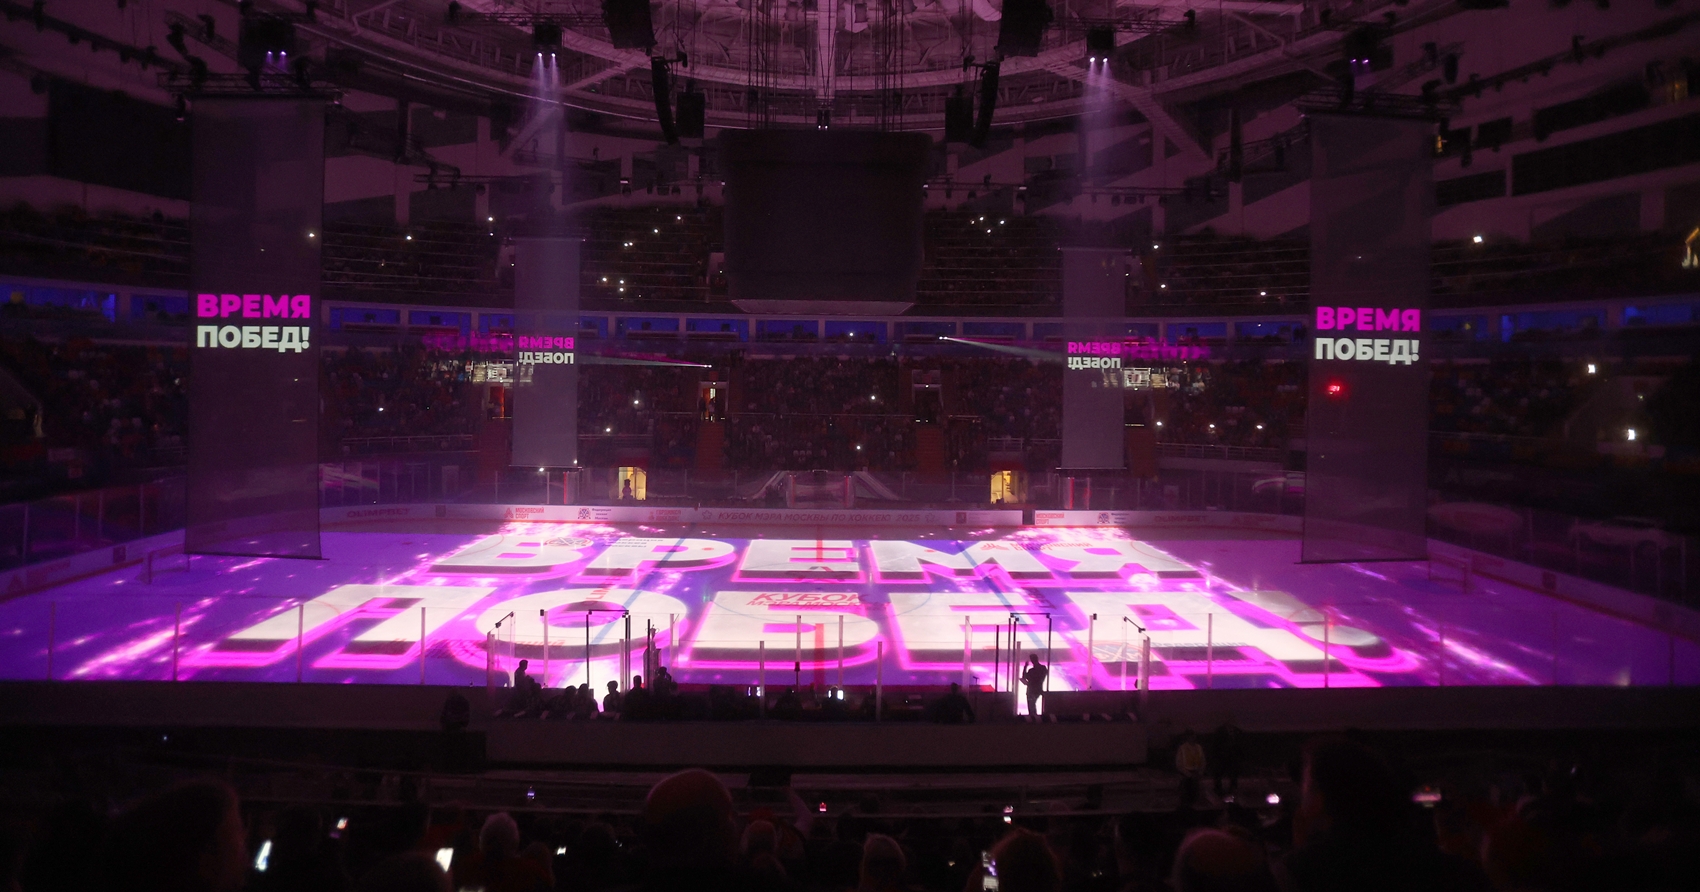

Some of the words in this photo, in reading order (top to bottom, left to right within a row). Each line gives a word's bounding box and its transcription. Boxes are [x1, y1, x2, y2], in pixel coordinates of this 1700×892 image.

[197, 294, 311, 319] ВРЕМЯ
[1316, 306, 1421, 332] ВРЕМЯ
[197, 325, 311, 353] ПОБЕД!
[1315, 338, 1420, 365] ПОБЕД!
[718, 512, 753, 520] КУБОК
[754, 512, 783, 521] МЭРА
[784, 513, 830, 522] МОСКВЫ
[831, 514, 847, 522] ПО
[847, 514, 892, 522] ХОККЕЮ
[896, 514, 920, 522] 2025
[427, 536, 1205, 581] ВРЕМЯ
[752, 593, 870, 602] КУБОК
